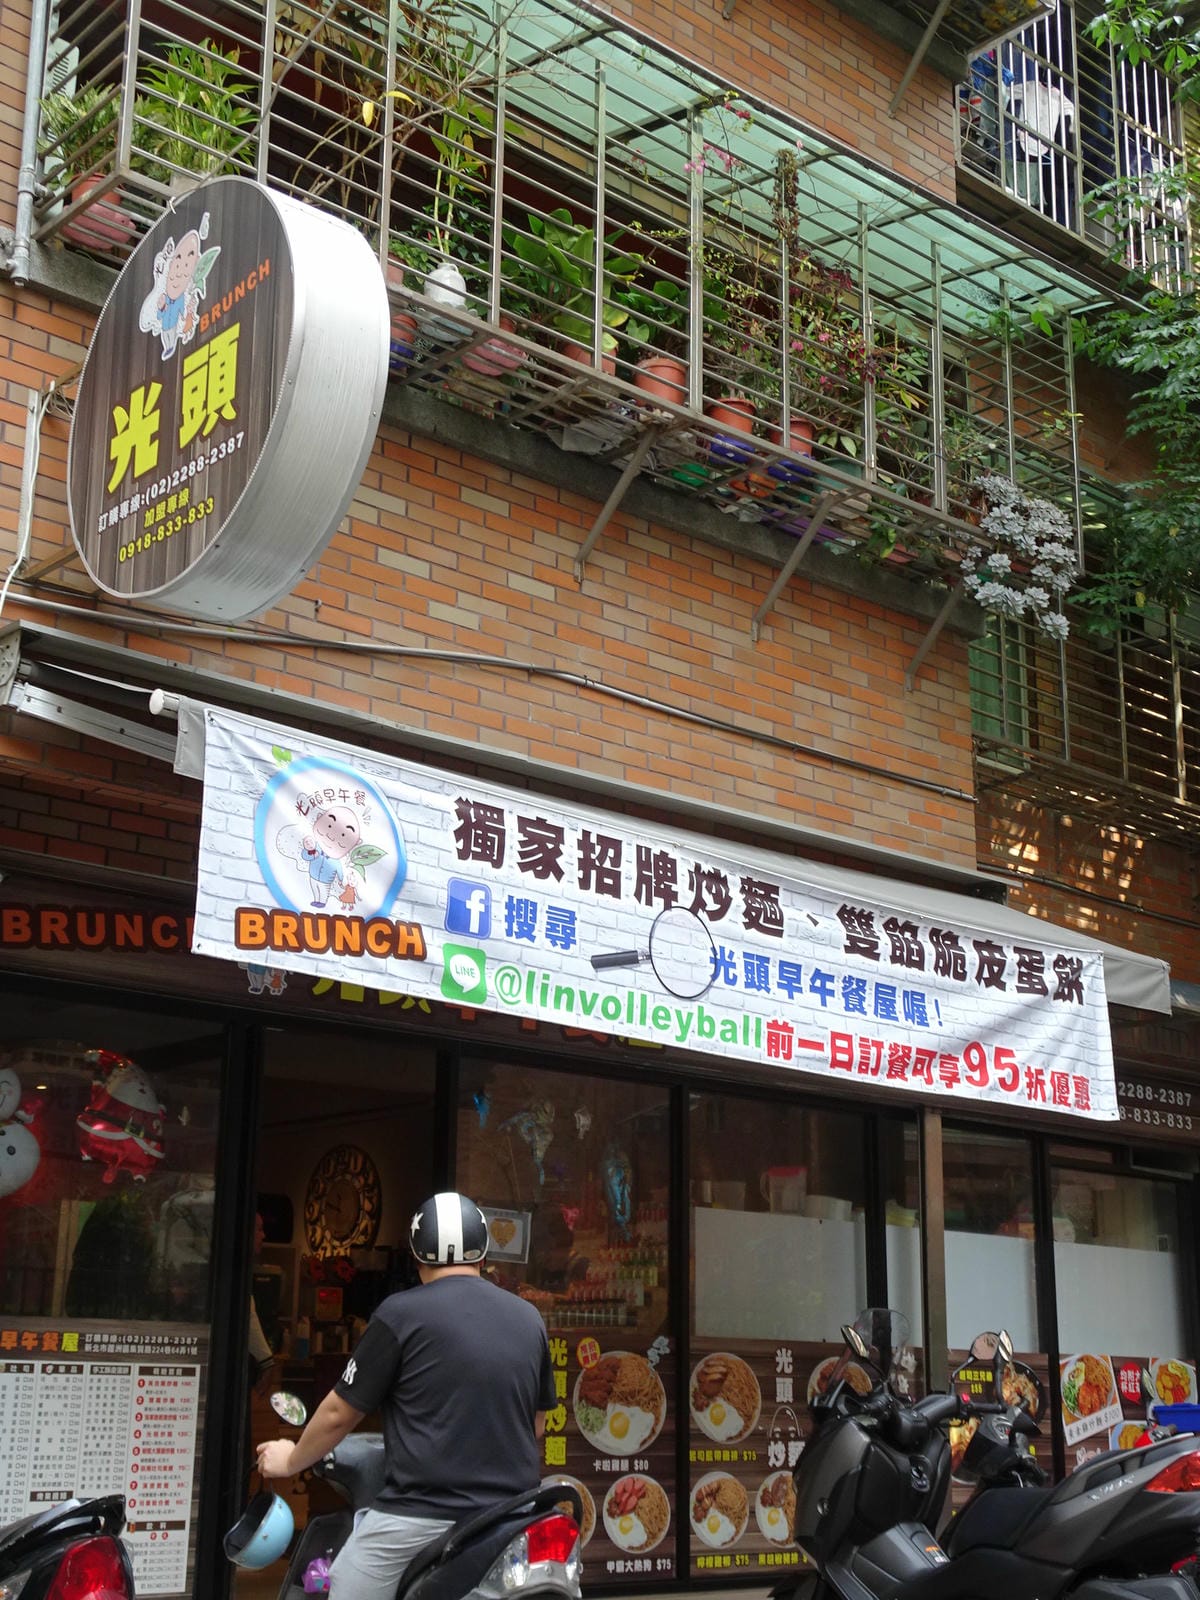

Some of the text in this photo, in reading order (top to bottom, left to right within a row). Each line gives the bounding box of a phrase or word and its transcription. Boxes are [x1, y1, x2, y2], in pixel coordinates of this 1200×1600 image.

[200, 258, 271, 333] BRUNCH
[107, 322, 241, 494] 光頭
[118, 496, 215, 563] 0918-833-833
[143, 487, 190, 529] 加盟專線
[2, 908, 195, 949] BRUNC
[236, 910, 426, 959] BRUNCH
[504, 894, 578, 950] 搜尋
[454, 964, 476, 978] LINE
[494, 965, 762, 1049] @linvolleyball
